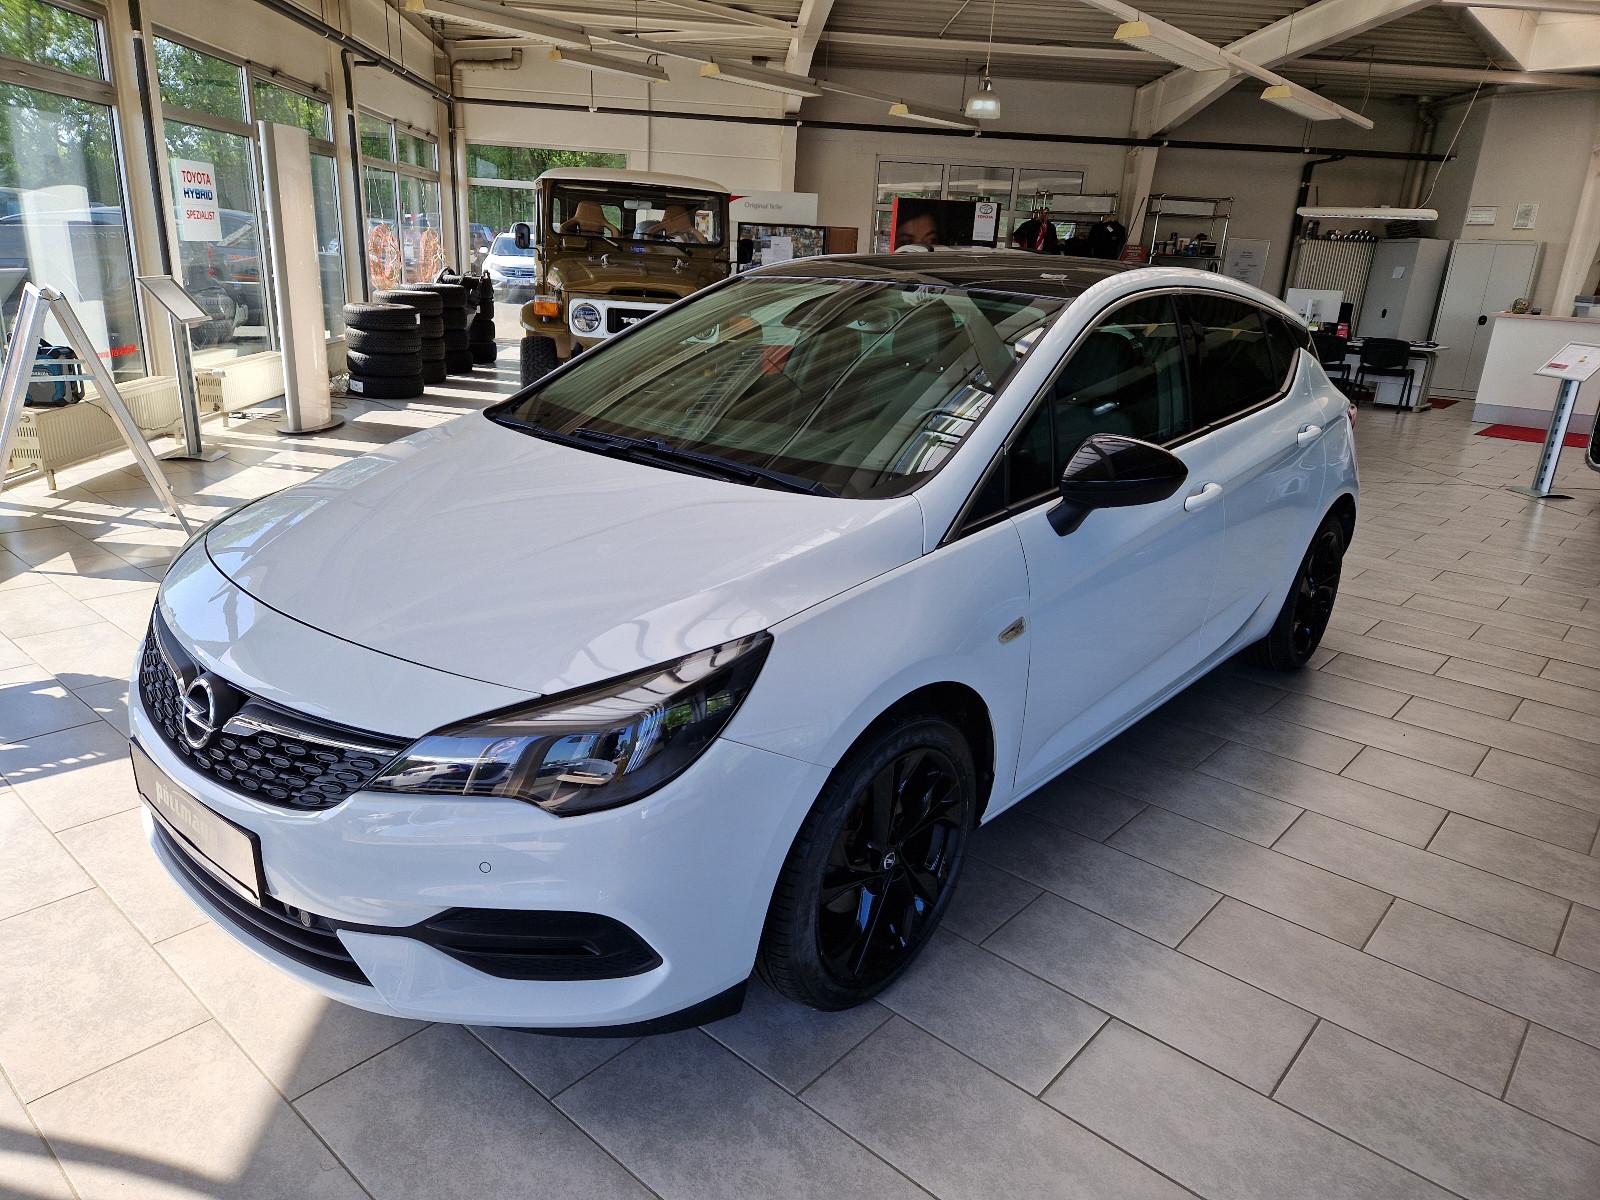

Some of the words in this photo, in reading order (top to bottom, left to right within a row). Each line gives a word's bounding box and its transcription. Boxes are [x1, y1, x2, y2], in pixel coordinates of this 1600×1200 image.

[181, 170, 212, 185] TOYOTA
[183, 188, 213, 200] HYBRID
[186, 209, 215, 220] SPEZIALIST
